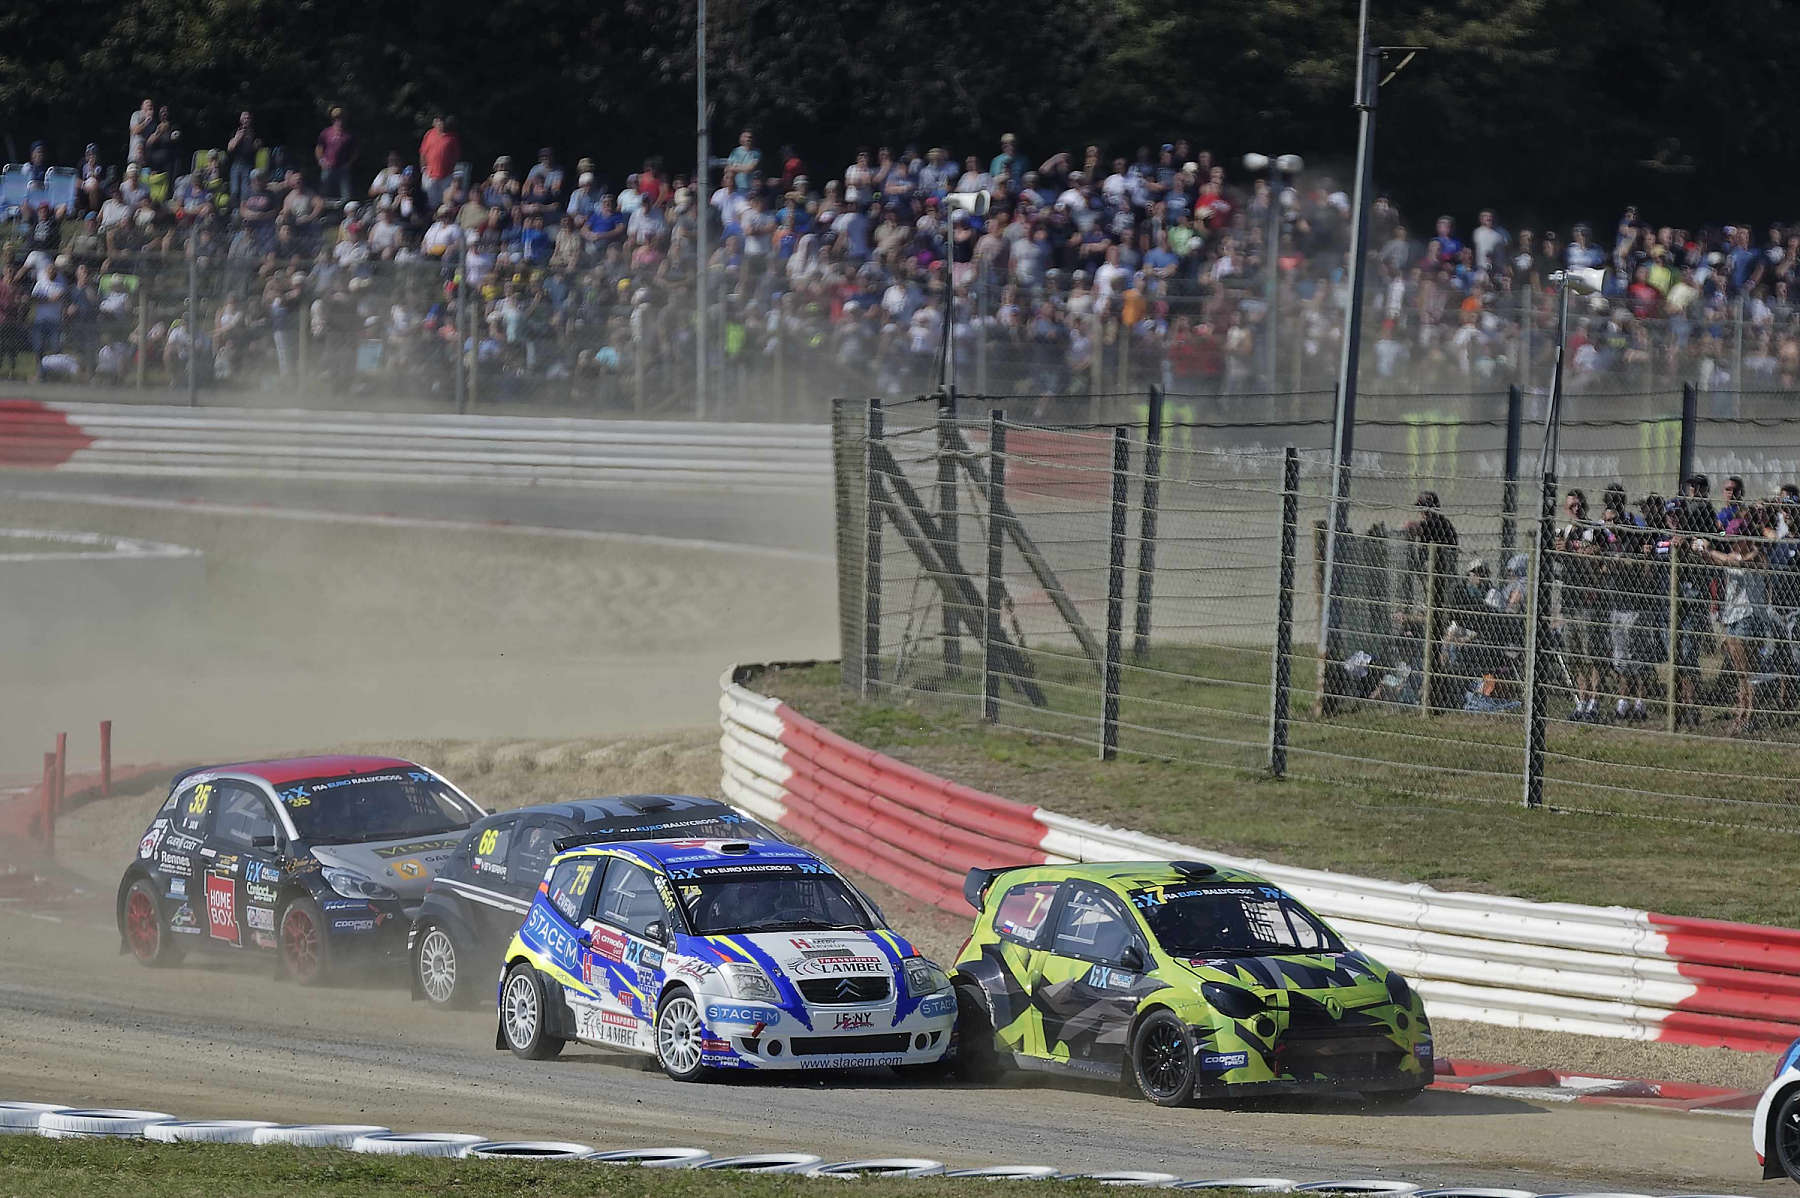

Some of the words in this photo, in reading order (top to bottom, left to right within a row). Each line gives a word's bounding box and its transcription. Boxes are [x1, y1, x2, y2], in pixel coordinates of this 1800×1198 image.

[312, 784, 328, 792] FIA
[328, 779, 351, 788] EURO
[351, 774, 402, 784] RALLYCROSS
[189, 784, 212, 813] 35
[662, 818, 719, 828] RALLYCROSS
[479, 829, 499, 855] 66
[743, 865, 792, 873] RALLYCROSS
[569, 865, 594, 896] 75
[210, 889, 231, 910] HOME
[1143, 886, 1168, 904] 7
[1178, 890, 1202, 898] EURO
[1202, 888, 1254, 896] RALLYCROSS
[1028, 892, 1045, 922] 7
[211, 908, 234, 927] BOX
[529, 909, 577, 963] STACEM
[822, 963, 884, 973] LAMBEC
[603, 1013, 637, 1027] TRANSPORTS
[708, 1007, 778, 1022] STACEM
[600, 1025, 637, 1046] LAMBEC
[800, 1056, 903, 1069] www.stacem.com
[1205, 1055, 1245, 1063] COOPER
